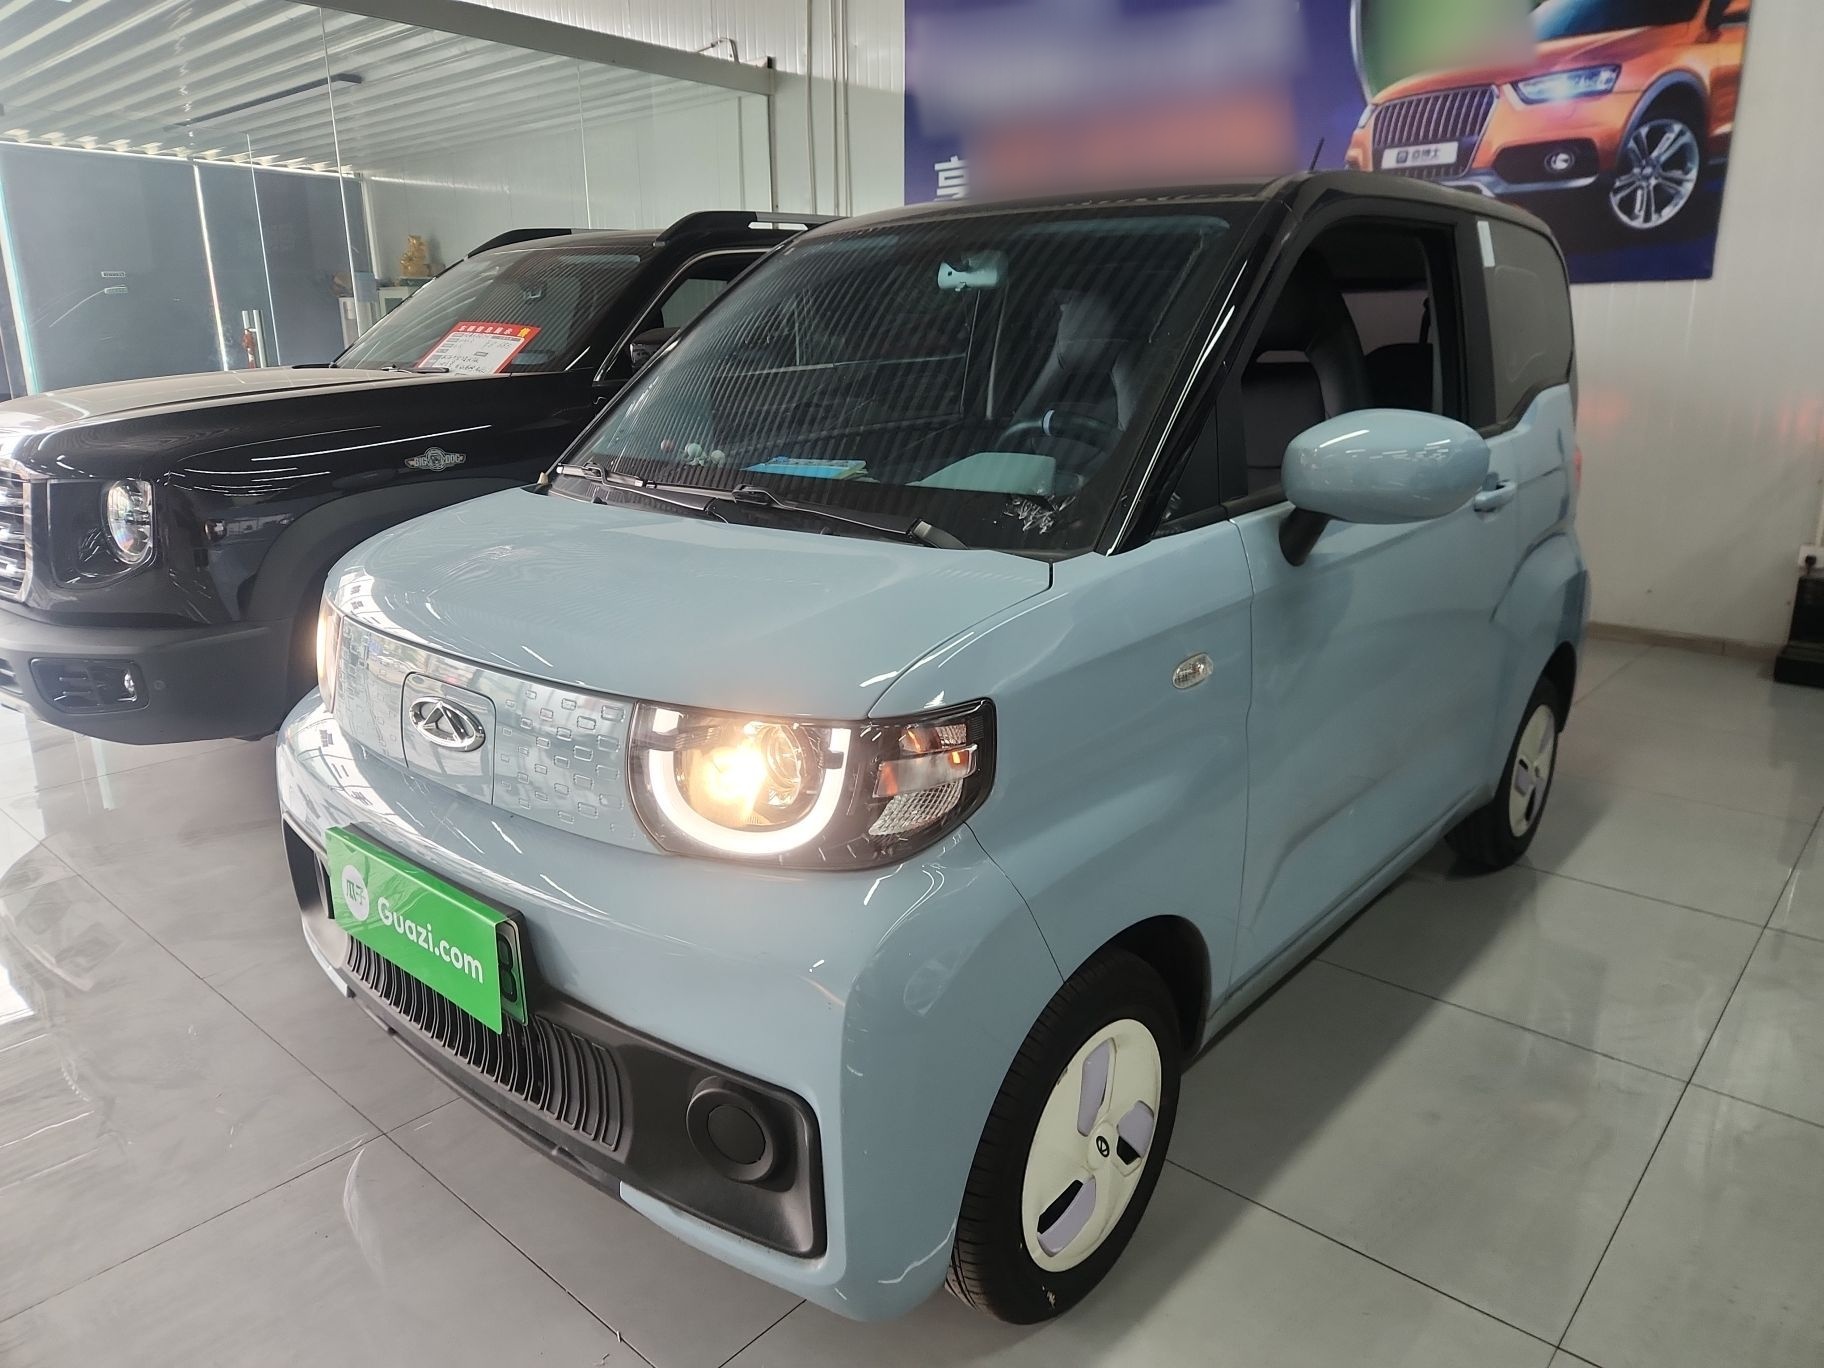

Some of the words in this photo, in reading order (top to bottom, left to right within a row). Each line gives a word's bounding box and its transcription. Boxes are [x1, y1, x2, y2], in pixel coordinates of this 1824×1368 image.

[414, 457, 427, 467] BIG
[445, 454, 460, 464] DOG
[377, 896, 484, 984] Guazi.com
